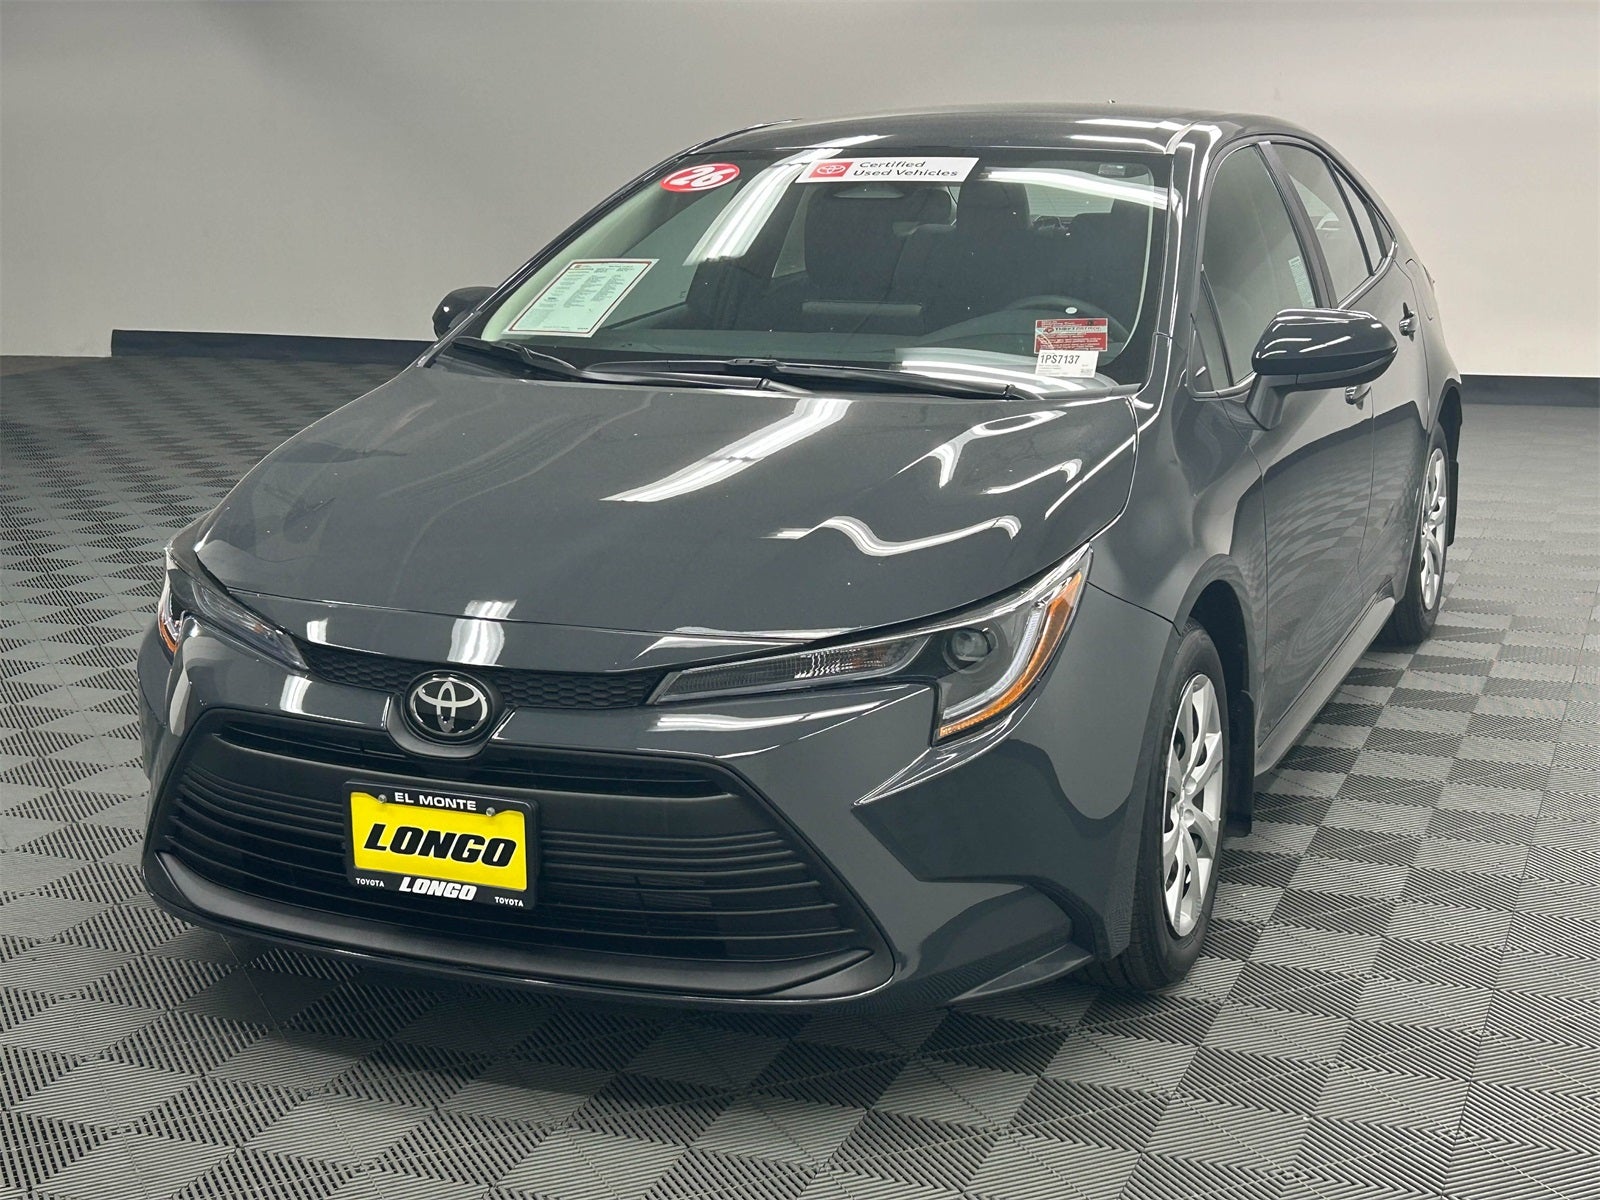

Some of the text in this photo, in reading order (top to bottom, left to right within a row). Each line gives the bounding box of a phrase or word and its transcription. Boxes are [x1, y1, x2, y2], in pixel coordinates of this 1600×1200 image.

[669, 166, 736, 187] 26
[896, 169, 958, 177] Vehicles
[1040, 354, 1080, 364] 1PS7137
[394, 792, 477, 811] EL MONTE
[364, 823, 517, 867] LONGO
[355, 877, 385, 888] TOYOTA
[399, 876, 477, 901] LONGO
[494, 896, 524, 907] TOYOTA
